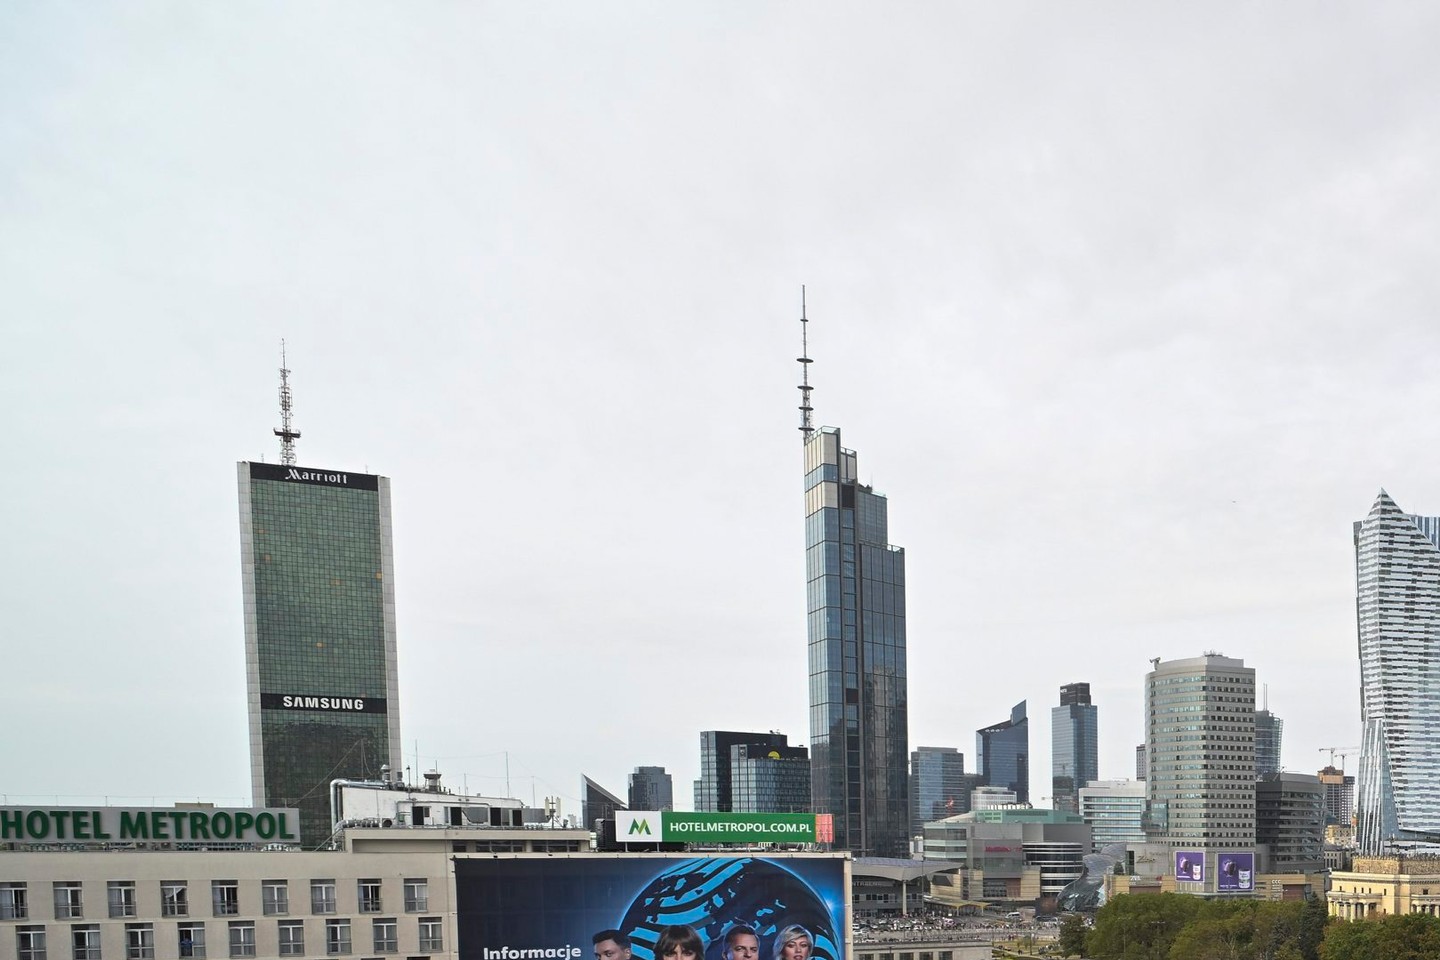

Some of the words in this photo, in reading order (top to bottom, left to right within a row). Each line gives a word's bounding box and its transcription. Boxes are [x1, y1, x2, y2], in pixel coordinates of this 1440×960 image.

[285, 468, 348, 484] Marriott
[283, 695, 364, 711] SAMSUNG
[1, 810, 110, 840] HOTEL
[119, 810, 294, 840] METROPOL
[669, 821, 812, 835] HOTELMETROPOL.COM.PL
